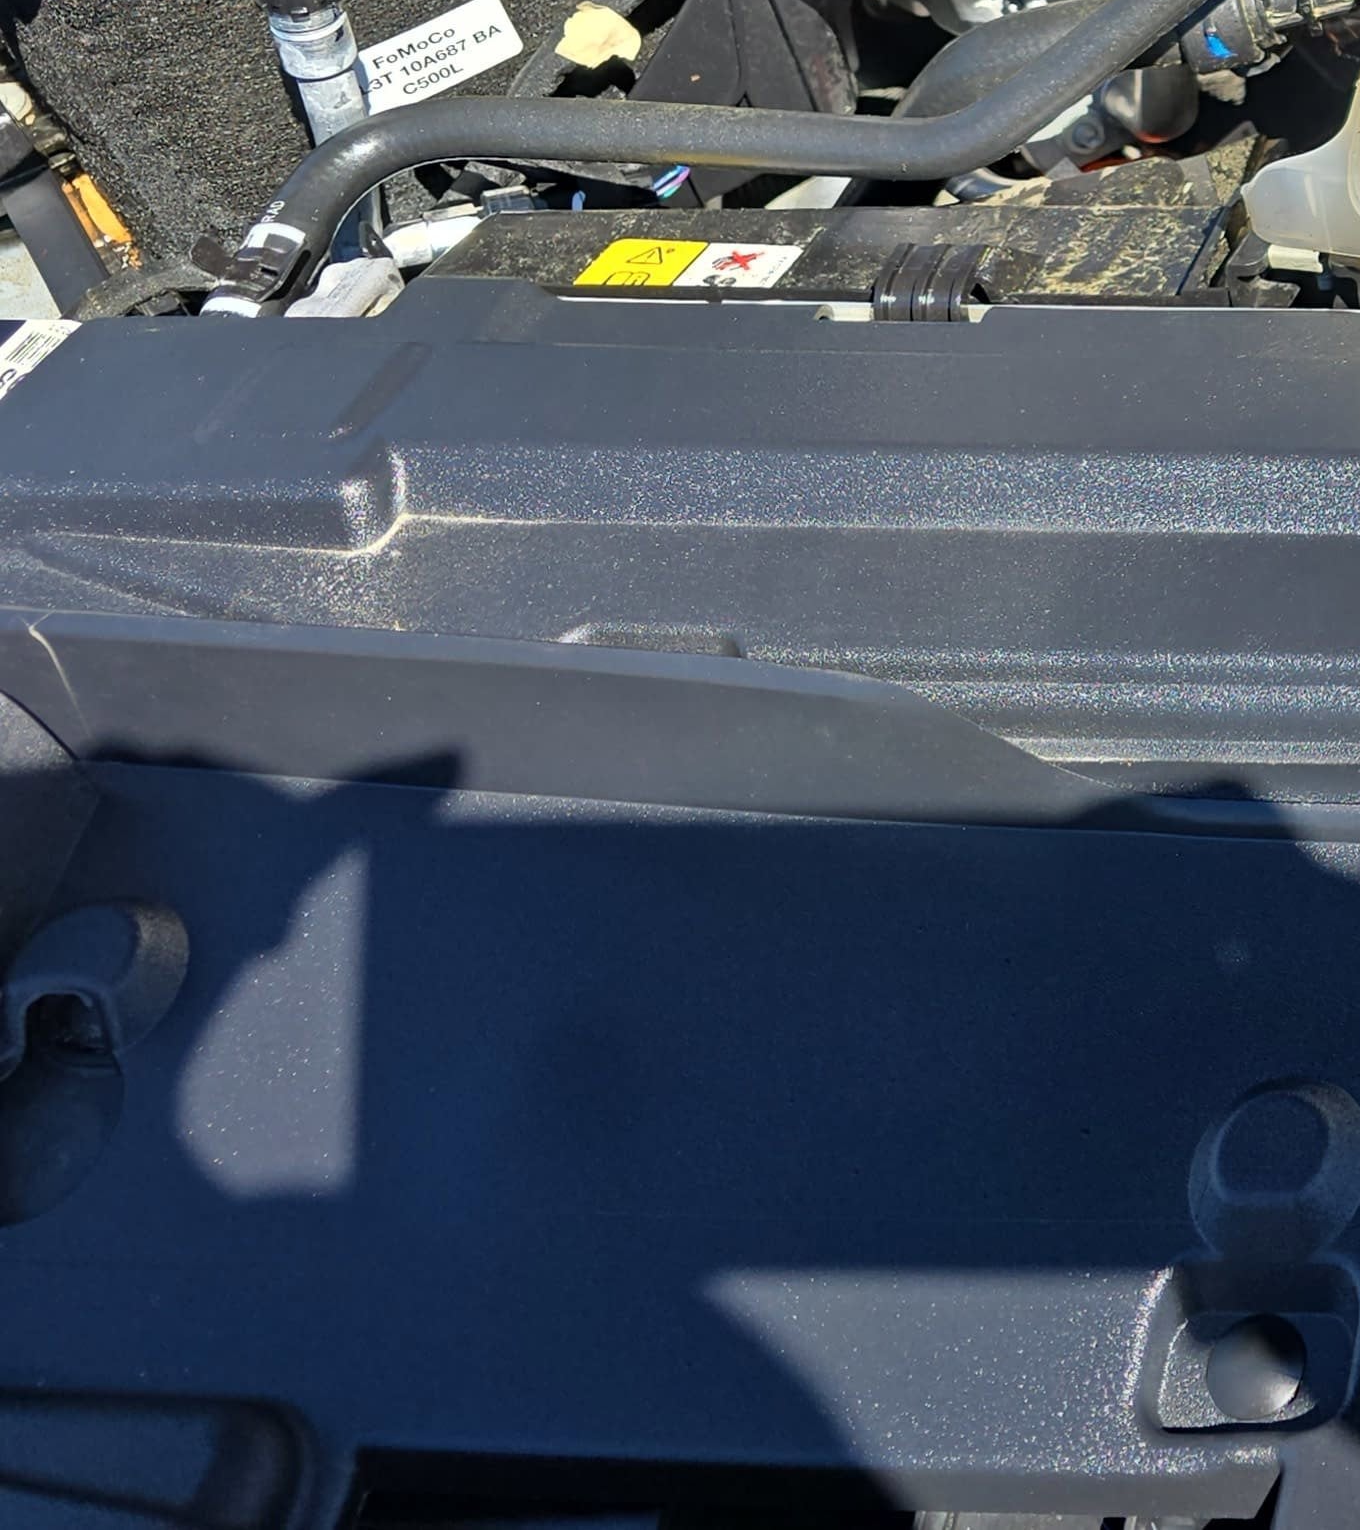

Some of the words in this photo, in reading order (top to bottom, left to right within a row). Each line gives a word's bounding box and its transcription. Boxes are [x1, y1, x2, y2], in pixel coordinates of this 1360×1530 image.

[372, 27, 456, 70] FoMoCo
[400, 38, 467, 77] 10A687
[472, 24, 503, 44] BA
[402, 63, 465, 95] C500L
